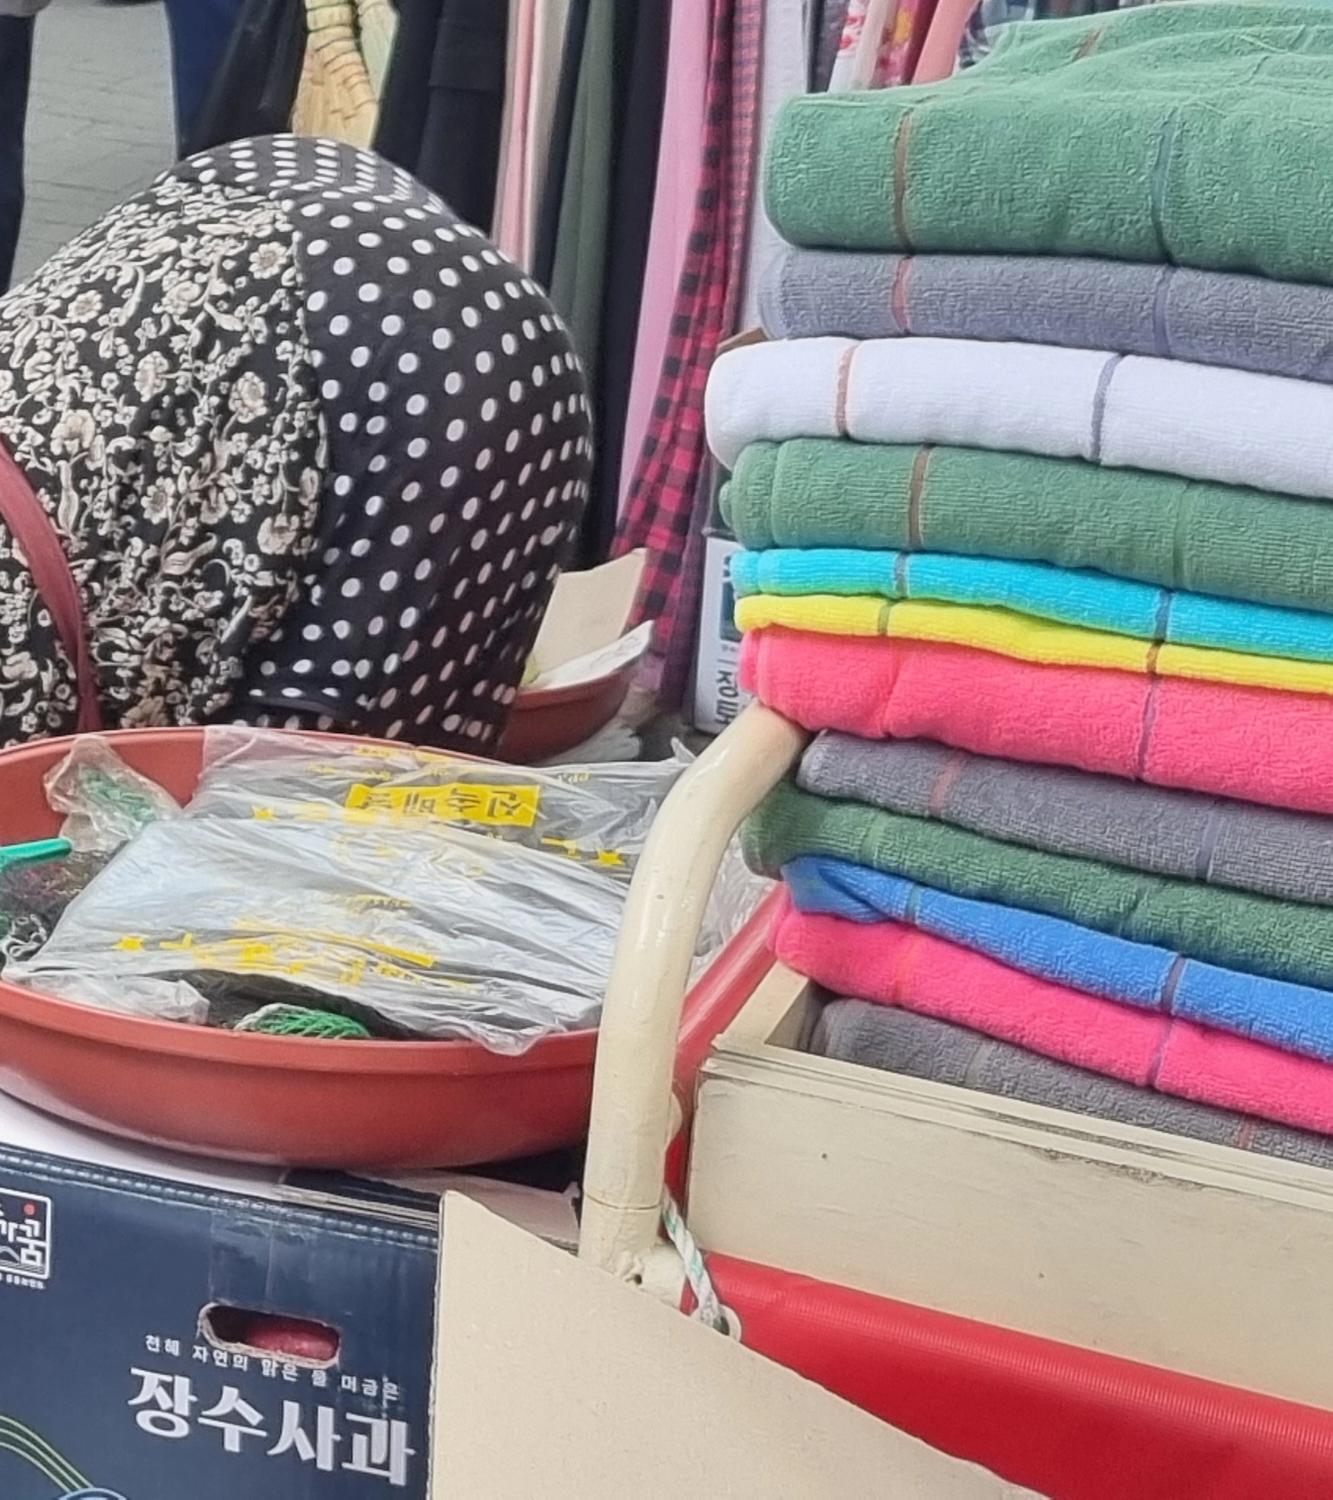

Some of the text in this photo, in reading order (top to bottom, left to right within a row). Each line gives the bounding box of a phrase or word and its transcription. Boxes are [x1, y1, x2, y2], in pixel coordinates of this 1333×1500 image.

[144, 1334, 181, 1357] 천혜
[191, 1344, 250, 1372] 자연의
[261, 1357, 300, 1382] 맑은
[340, 1374, 401, 1402] 머금은
[127, 1366, 416, 1487] 장수사과
